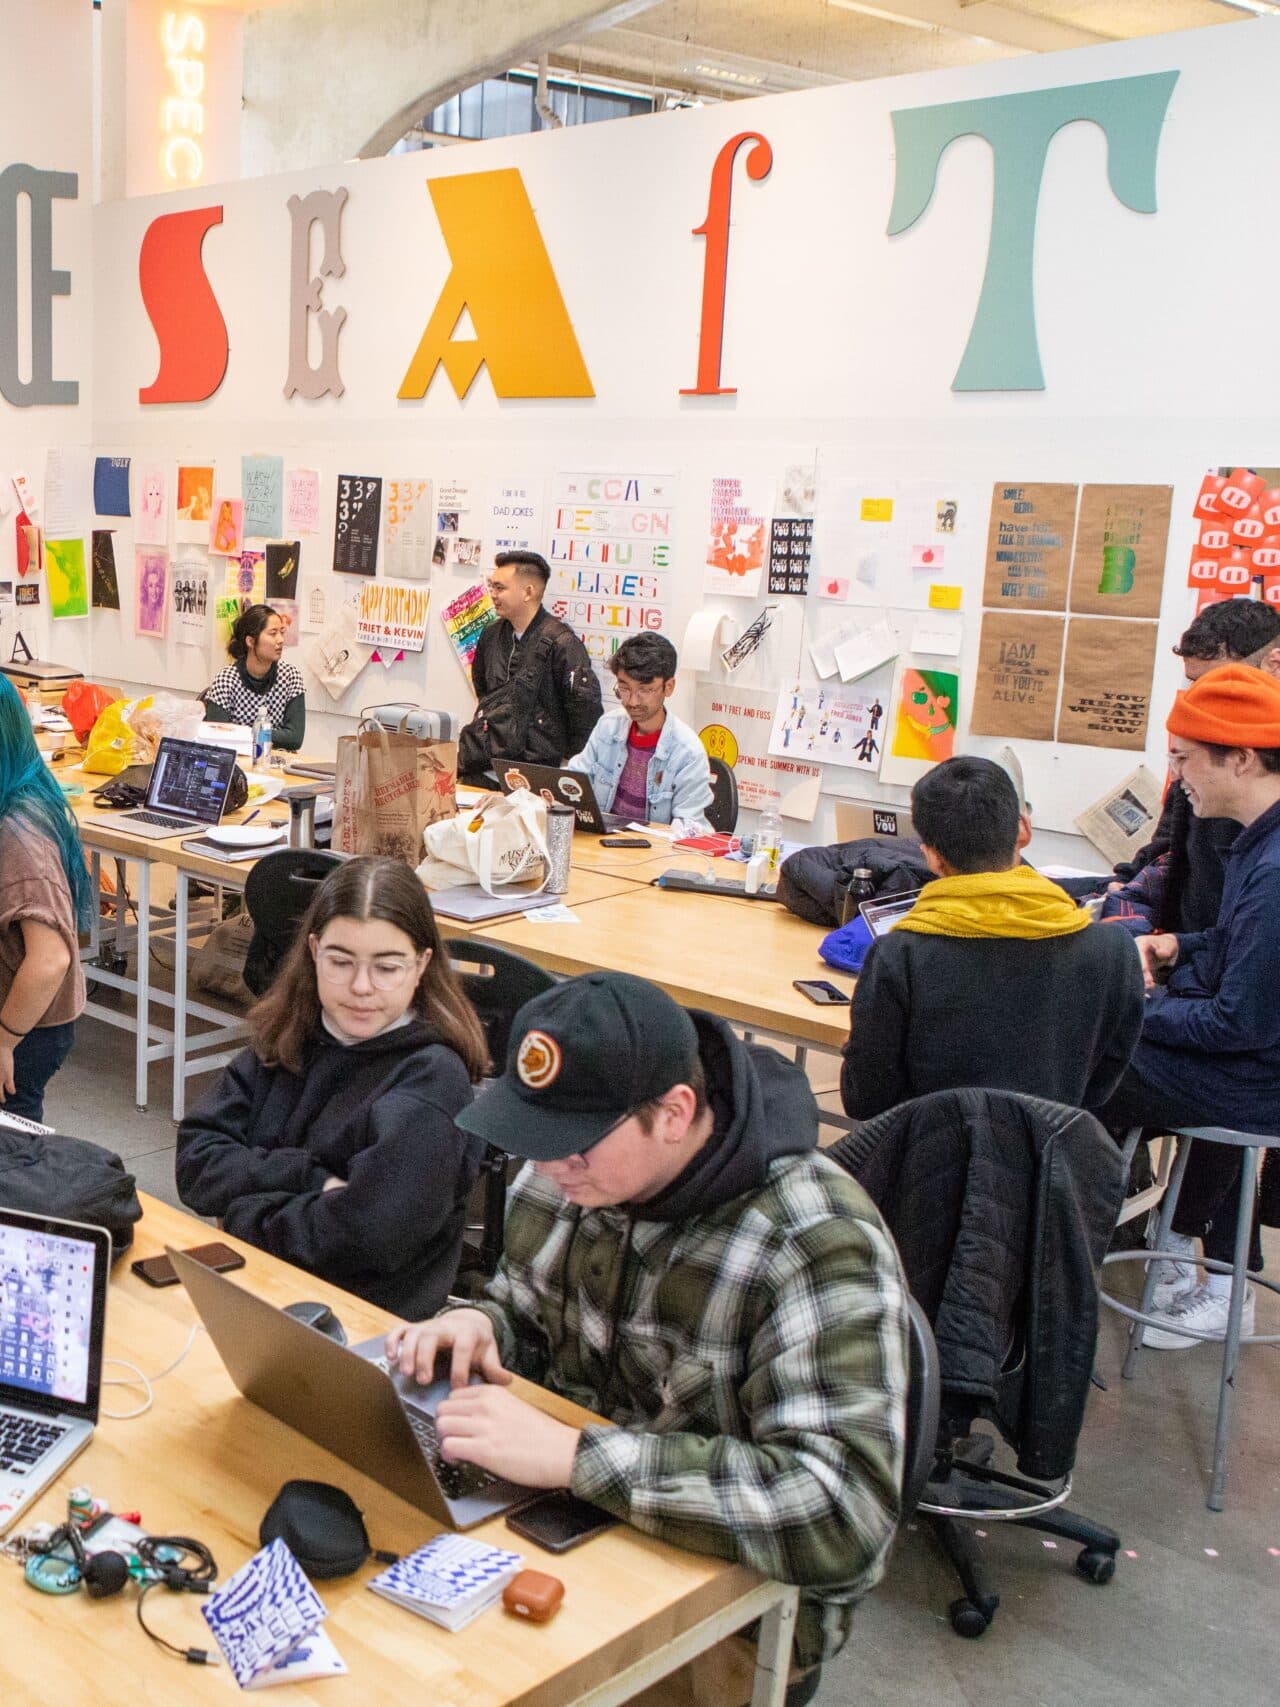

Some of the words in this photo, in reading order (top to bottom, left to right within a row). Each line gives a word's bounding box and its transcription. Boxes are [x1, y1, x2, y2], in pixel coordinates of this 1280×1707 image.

[161, 12, 206, 182] SPEC
[493, 506, 510, 516] DAD
[512, 507, 534, 517] JOKES
[550, 539, 670, 567] LECTUE
[360, 583, 384, 619] HAPPY
[384, 585, 431, 627] BIRTHDAY
[359, 622, 381, 634] TRIET
[384, 625, 391, 635] &
[394, 627, 424, 639] KEVIN
[1006, 643, 1036, 660] AM
[1079, 698, 1145, 711] REAP
[1103, 692, 1147, 703] YOU
[712, 702, 728, 713] DON'T
[729, 705, 742, 716] FRET
[744, 707, 755, 718] AND
[757, 710, 771, 721] FUSS
[1067, 705, 1145, 718] WHAT
[1100, 716, 1144, 727] YOU
[737, 754, 755, 766] SPEND
[757, 758, 768, 768] THE
[770, 760, 795, 773] SUMMER
[796, 765, 811, 776] WITH
[812, 767, 820, 777] US
[875, 814, 895, 822] FLUX
[875, 822, 896, 832] YOU
[228, 1614, 262, 1640] SAY
